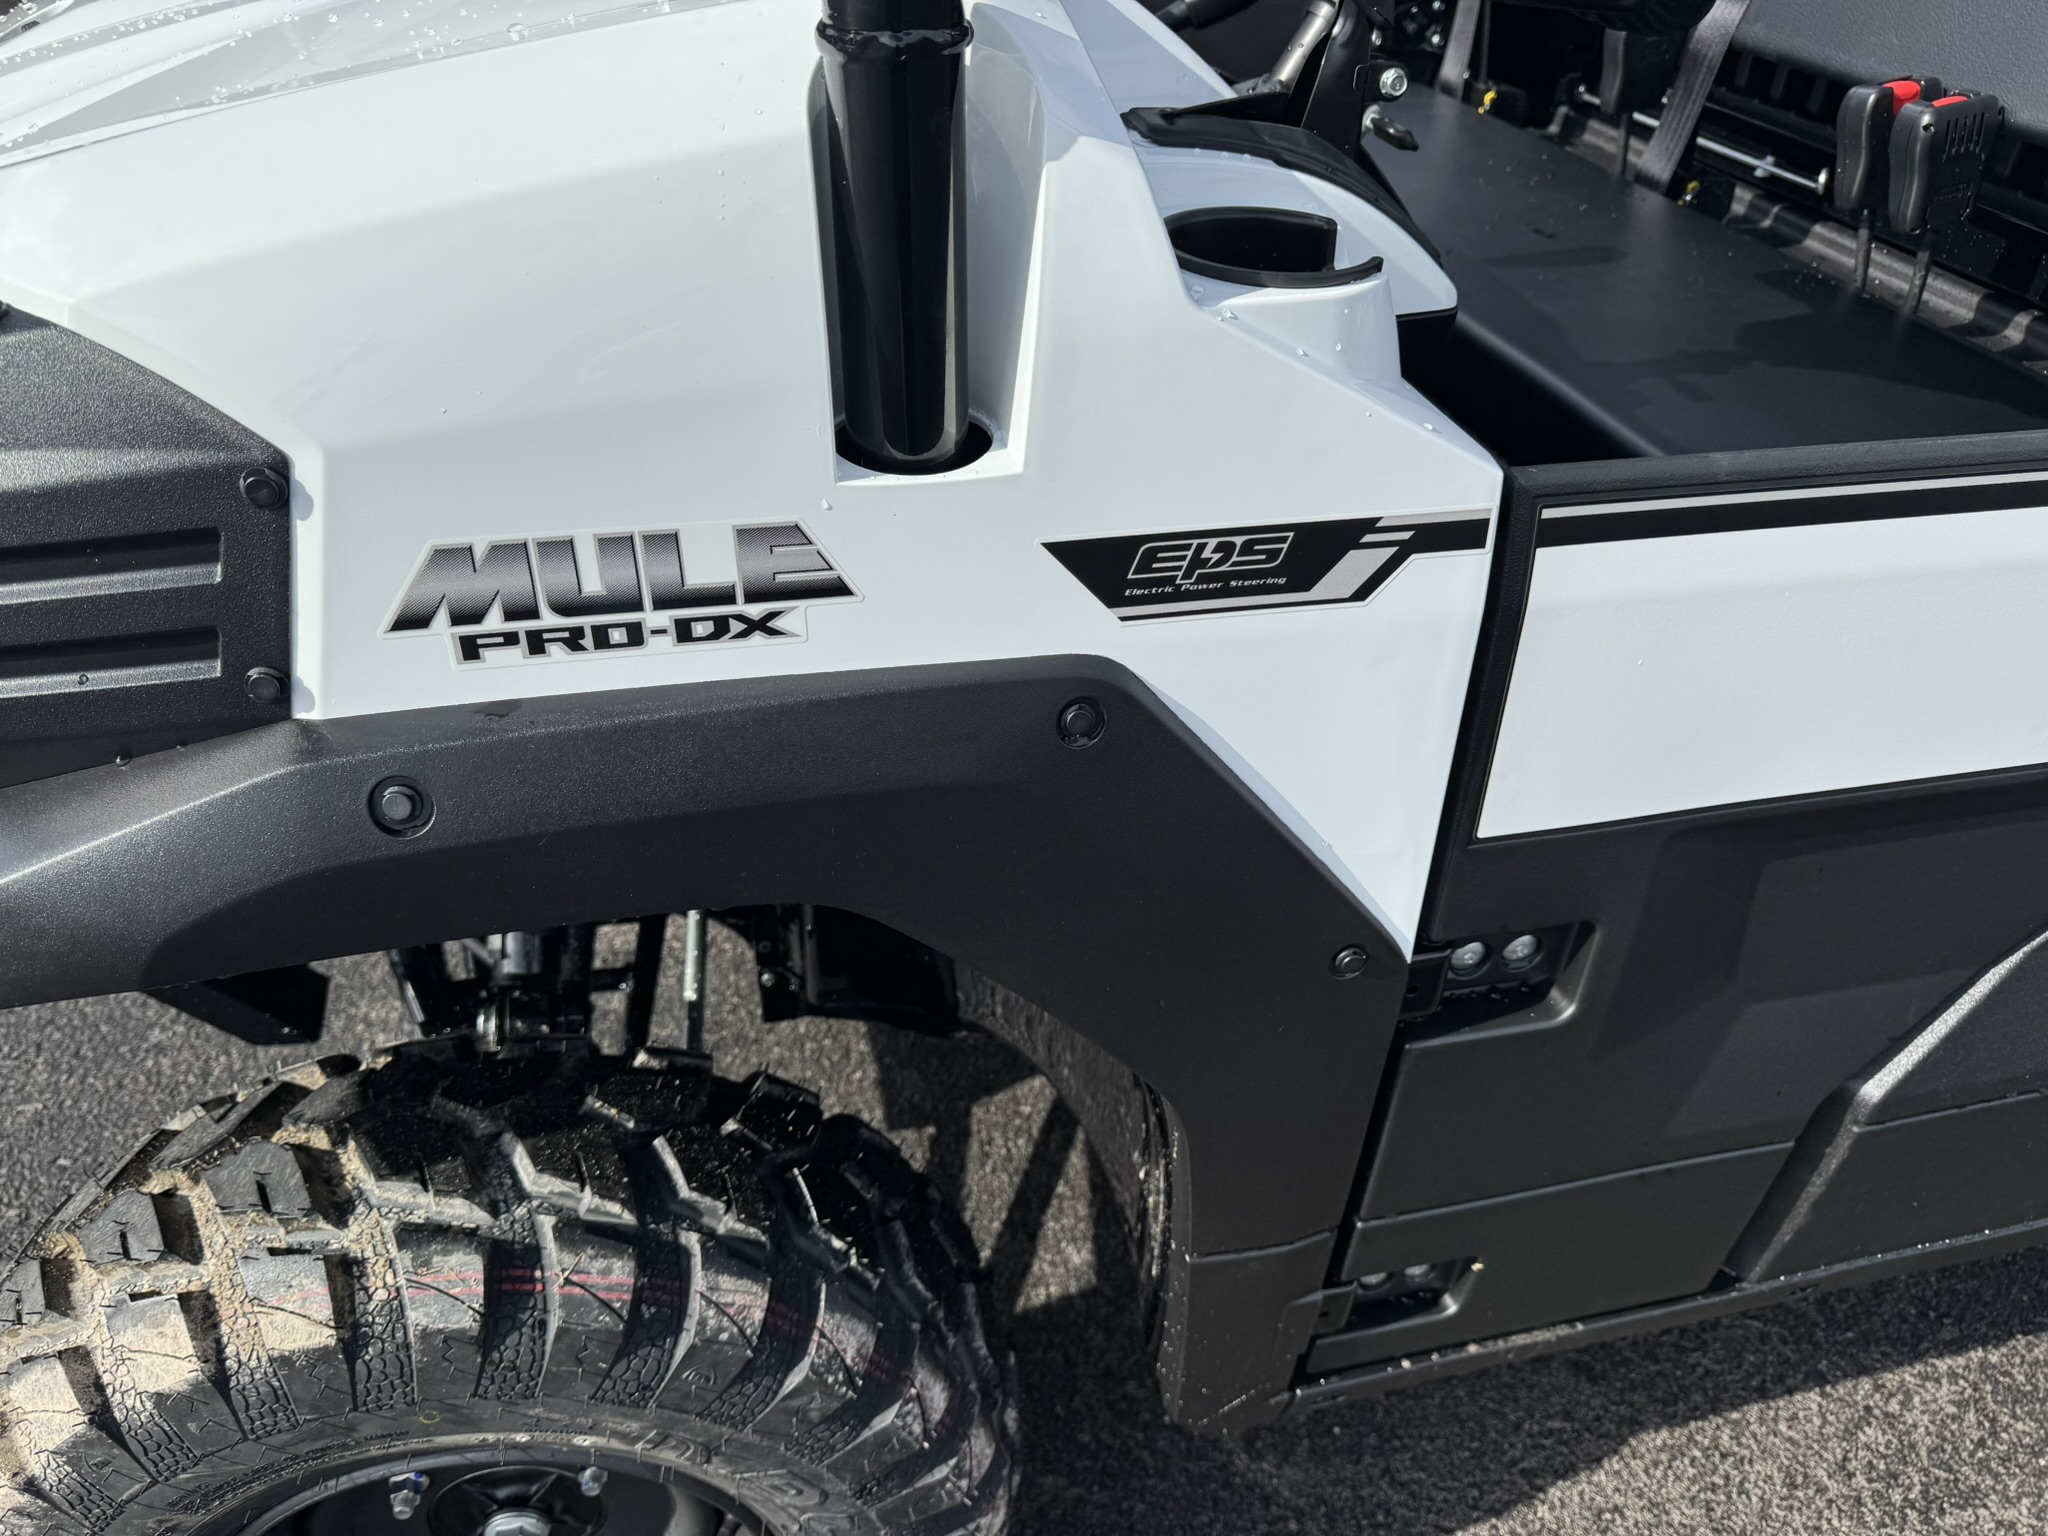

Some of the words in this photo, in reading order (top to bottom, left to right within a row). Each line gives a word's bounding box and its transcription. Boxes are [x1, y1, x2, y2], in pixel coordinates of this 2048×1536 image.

[384, 521, 857, 634] MULE
[1127, 532, 1295, 584] EPS
[1124, 586, 1175, 596] Electric
[1181, 582, 1224, 591] Power
[1229, 577, 1287, 587] Steering
[454, 606, 799, 664] PRO-DX
